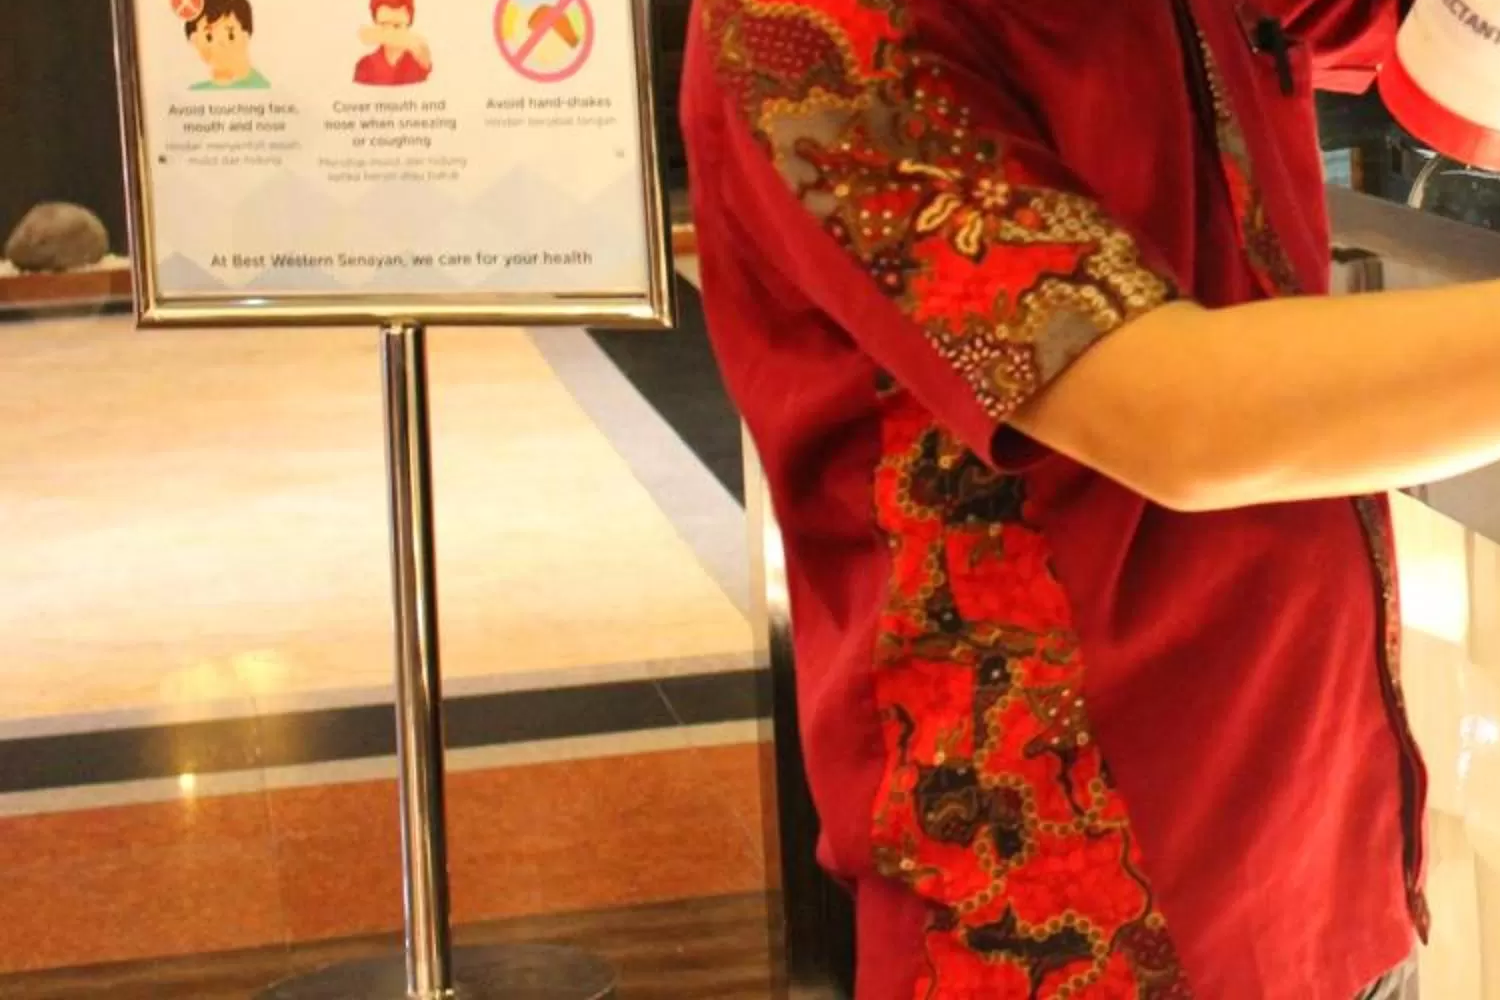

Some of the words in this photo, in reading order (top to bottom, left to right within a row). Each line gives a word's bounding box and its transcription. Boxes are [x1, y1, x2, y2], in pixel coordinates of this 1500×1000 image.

[168, 103, 206, 117] Avoid
[208, 102, 266, 118] touching
[332, 100, 371, 113] Cover
[374, 98, 418, 112] mouth
[421, 98, 447, 111] and
[485, 95, 525, 110] Avoid
[182, 119, 226, 134] mouth
[228, 119, 253, 133] and
[255, 121, 287, 133] nose
[323, 119, 357, 132] nose
[359, 116, 396, 130] when
[398, 116, 458, 132] sneezing
[351, 136, 366, 149] or
[368, 134, 433, 150] coughing
[209, 253, 228, 268] At
[231, 252, 265, 268] Best
[270, 251, 334, 268] Western
[411, 253, 433, 267] we
[438, 251, 472, 267] care
[475, 249, 499, 266] for
[502, 250, 539, 269] your
[542, 248, 594, 266] health
